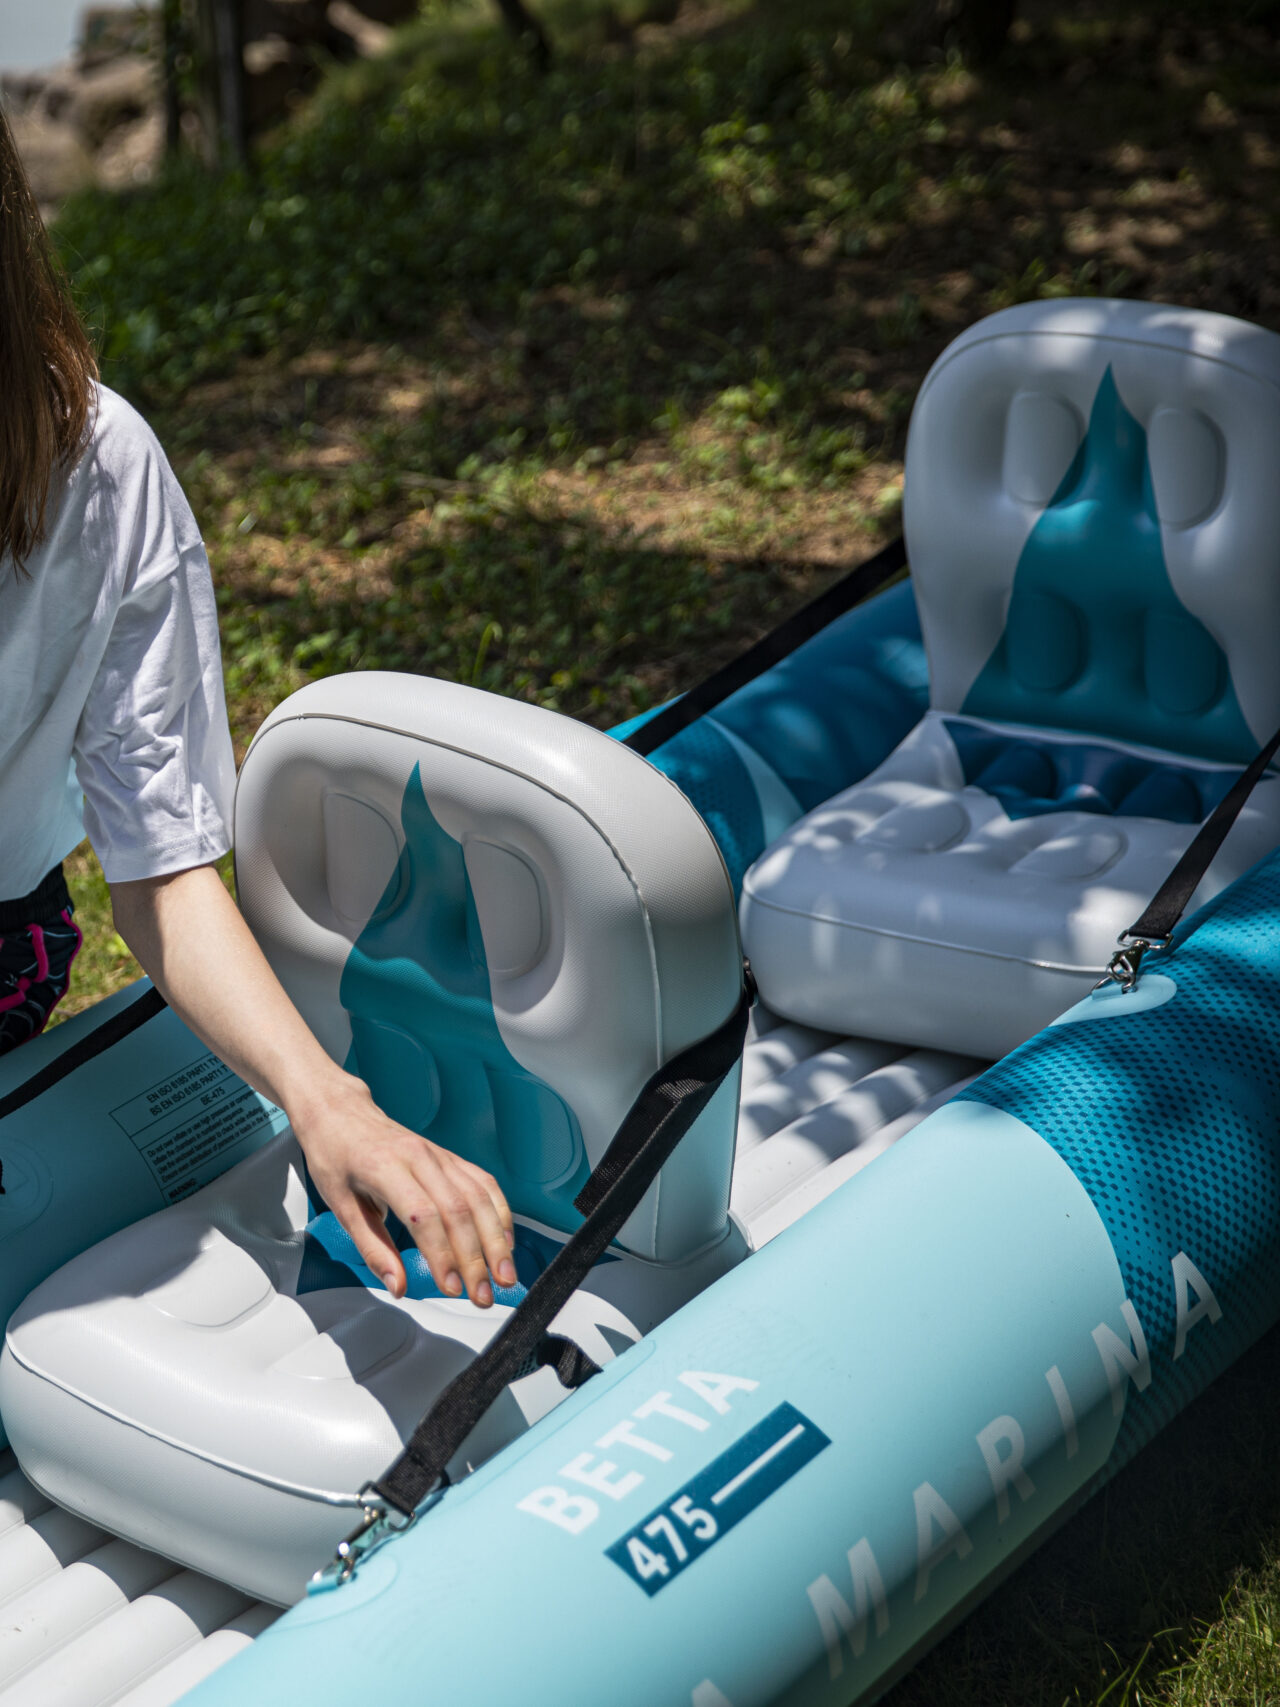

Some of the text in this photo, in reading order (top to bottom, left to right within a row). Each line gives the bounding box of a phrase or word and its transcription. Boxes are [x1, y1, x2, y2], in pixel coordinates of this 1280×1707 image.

[200, 1086, 224, 1105] BE-475
[519, 1370, 759, 1534] BETTA
[808, 1251, 1222, 1679] MARINA
[626, 1495, 719, 1583] 475
